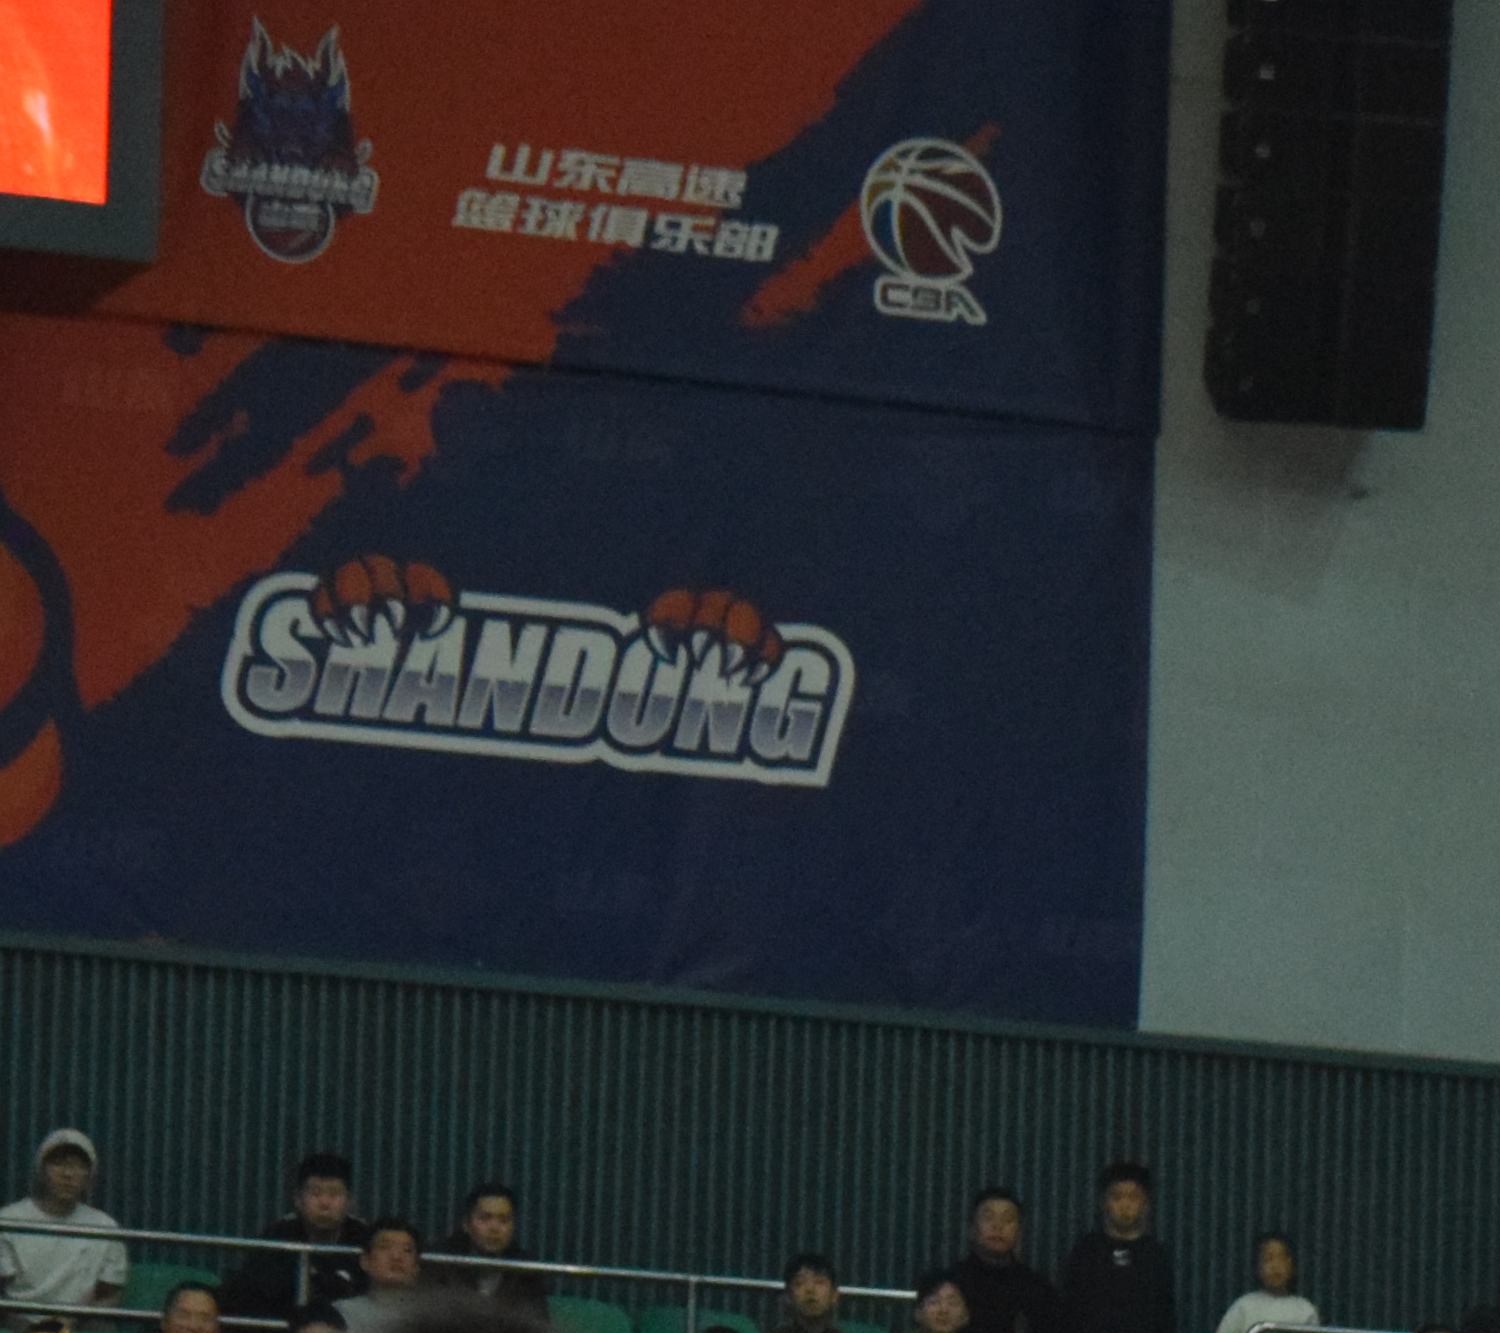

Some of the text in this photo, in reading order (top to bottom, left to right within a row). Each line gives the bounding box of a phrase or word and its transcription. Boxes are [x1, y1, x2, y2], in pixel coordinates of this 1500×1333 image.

[485, 143, 749, 210] 山东高速
[245, 598, 832, 762] SHANDONG
